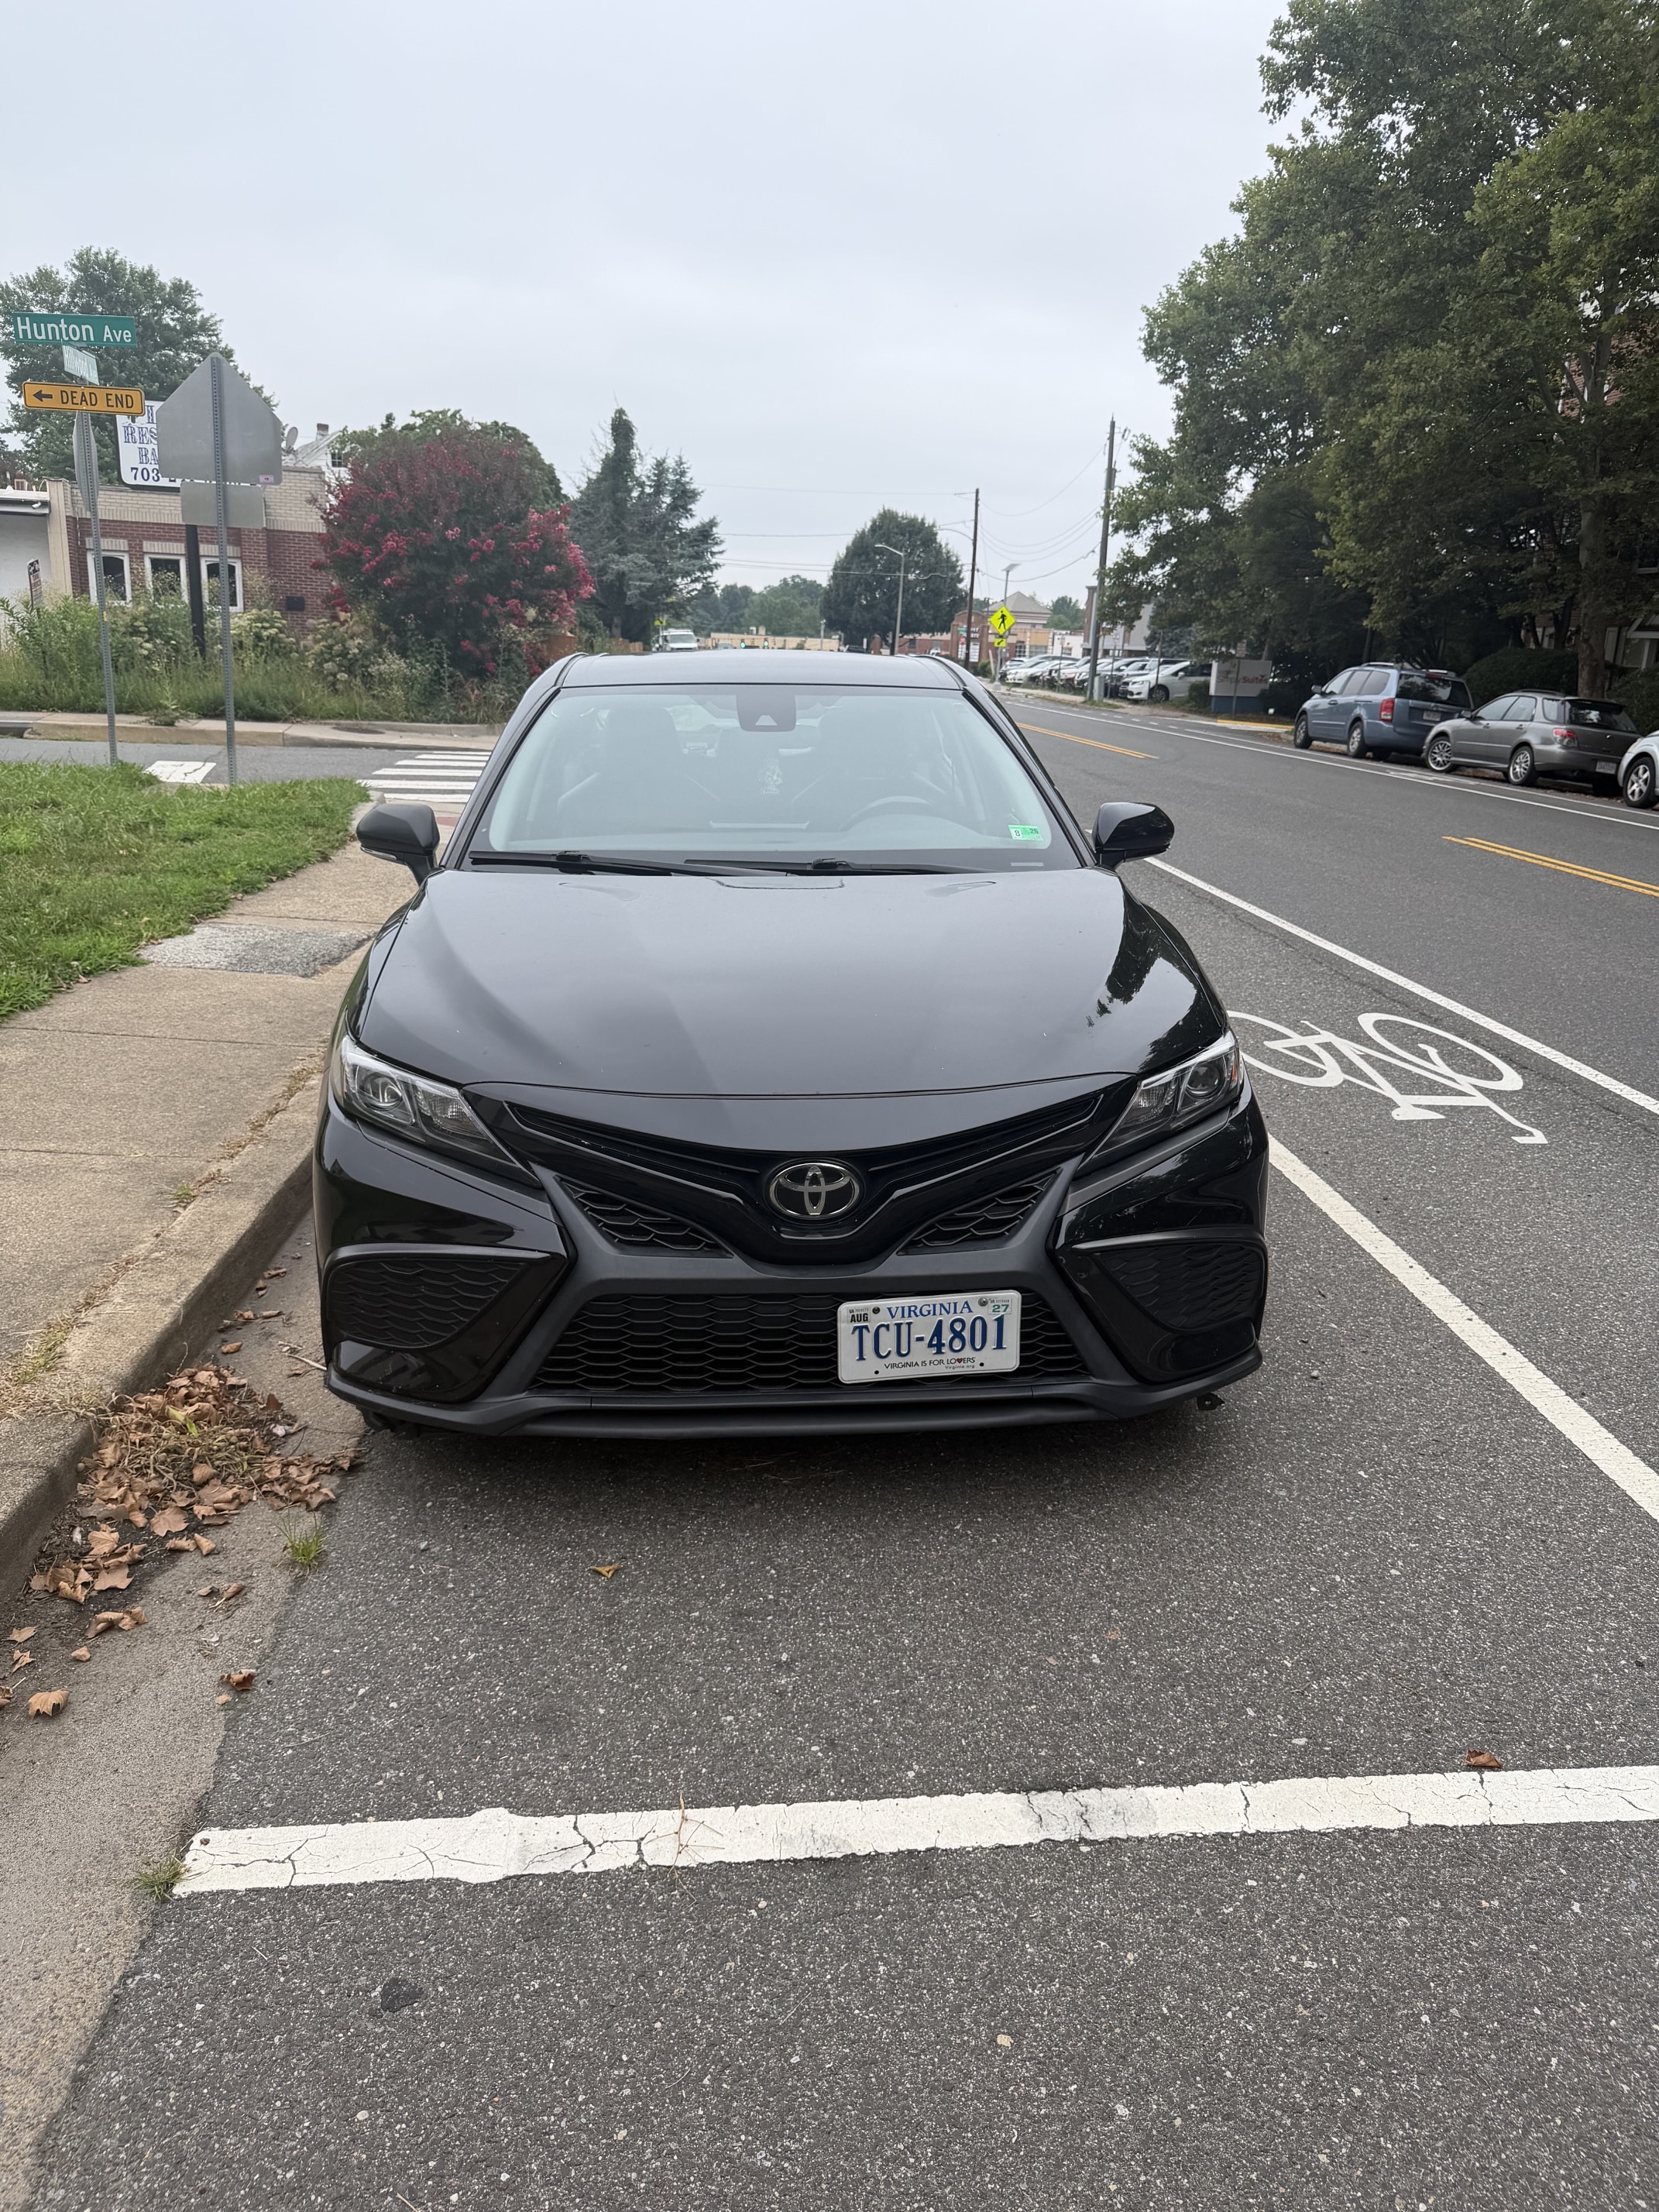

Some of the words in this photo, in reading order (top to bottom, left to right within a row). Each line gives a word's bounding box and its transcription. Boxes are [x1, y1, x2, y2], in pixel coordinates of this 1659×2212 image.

[16, 316, 94, 342] Hunton
[103, 325, 132, 342] Ave
[60, 390, 98, 407] DEAD
[105, 393, 134, 409] END
[131, 467, 160, 482] 703
[886, 1300, 974, 1320] VIRGINIA
[992, 1304, 1009, 1313] 27
[850, 1312, 868, 1323] AUG
[851, 1314, 1007, 1362] TCU-4801
[884, 1361, 919, 1369] VIRGINIA
